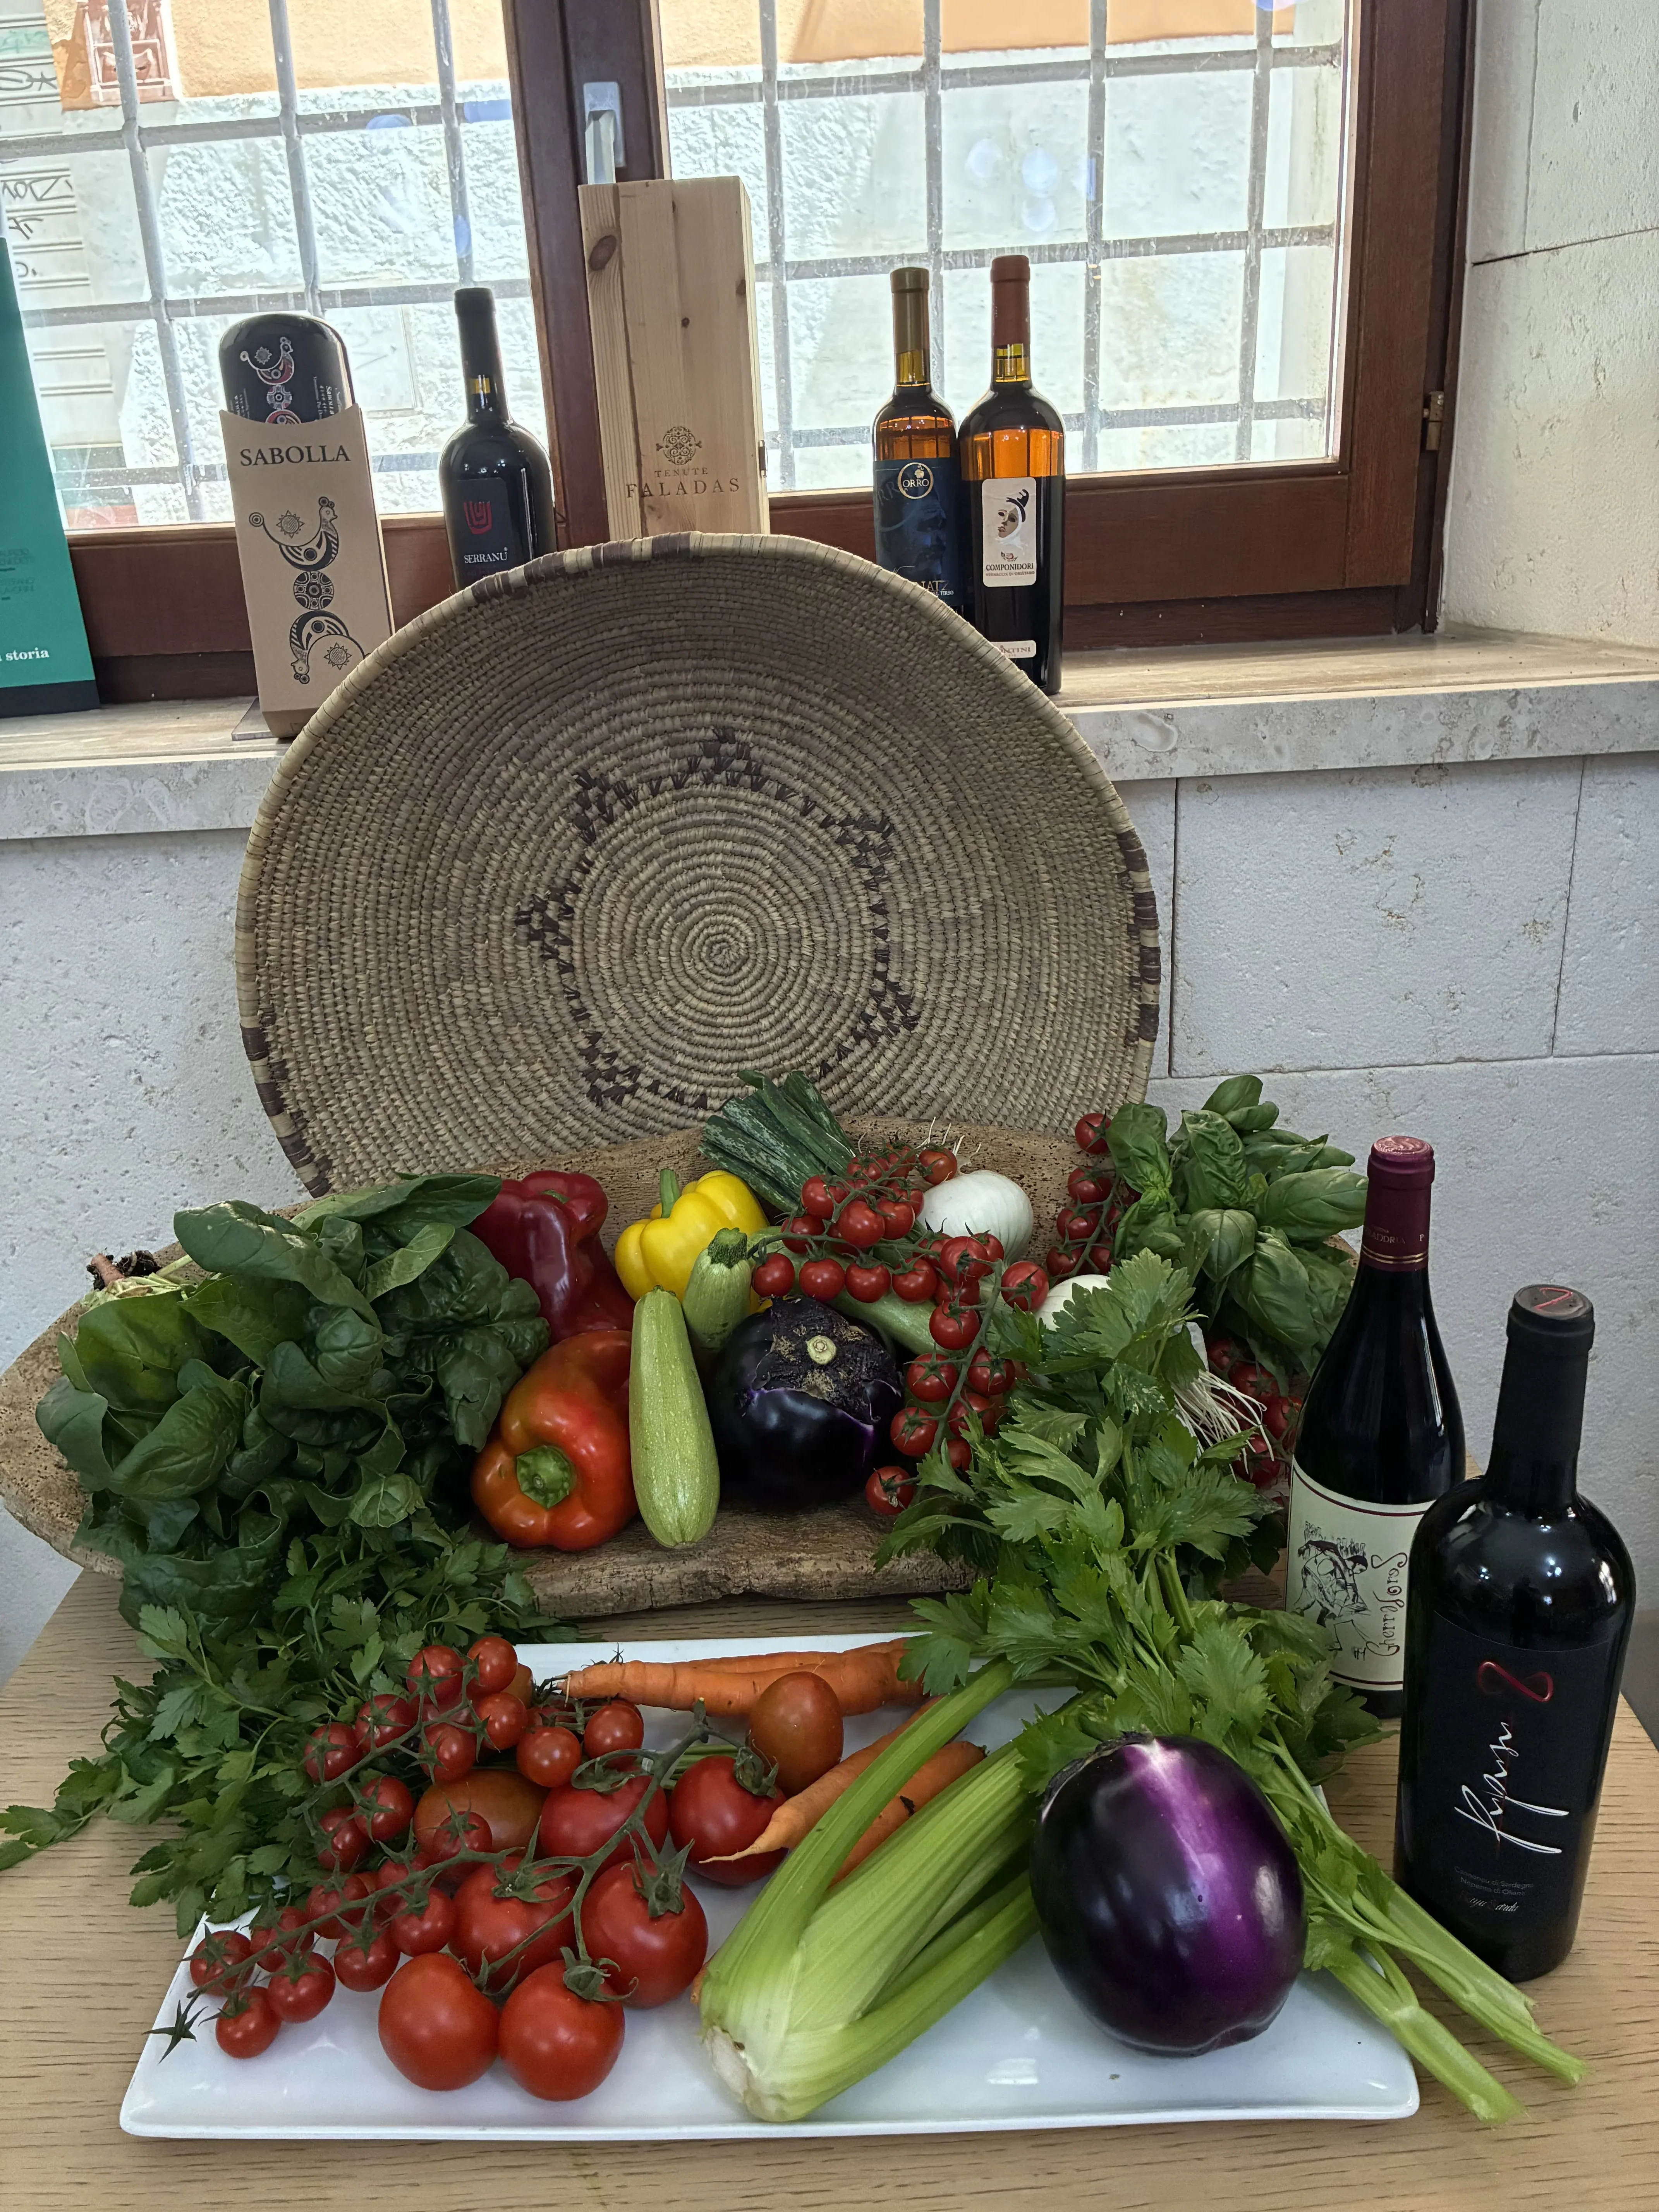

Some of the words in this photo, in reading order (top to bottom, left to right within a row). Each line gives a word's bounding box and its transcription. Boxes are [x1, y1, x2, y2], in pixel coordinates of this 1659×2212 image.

[240, 445, 351, 466] SABOLLA
[654, 467, 708, 477] TENUTE
[626, 477, 740, 498] FALADAS
[902, 479, 929, 488] ORRO
[986, 563, 1034, 571] COMPONIDORI
[5, 647, 50, 661] storia
[998, 645, 1030, 654] ONTINI
